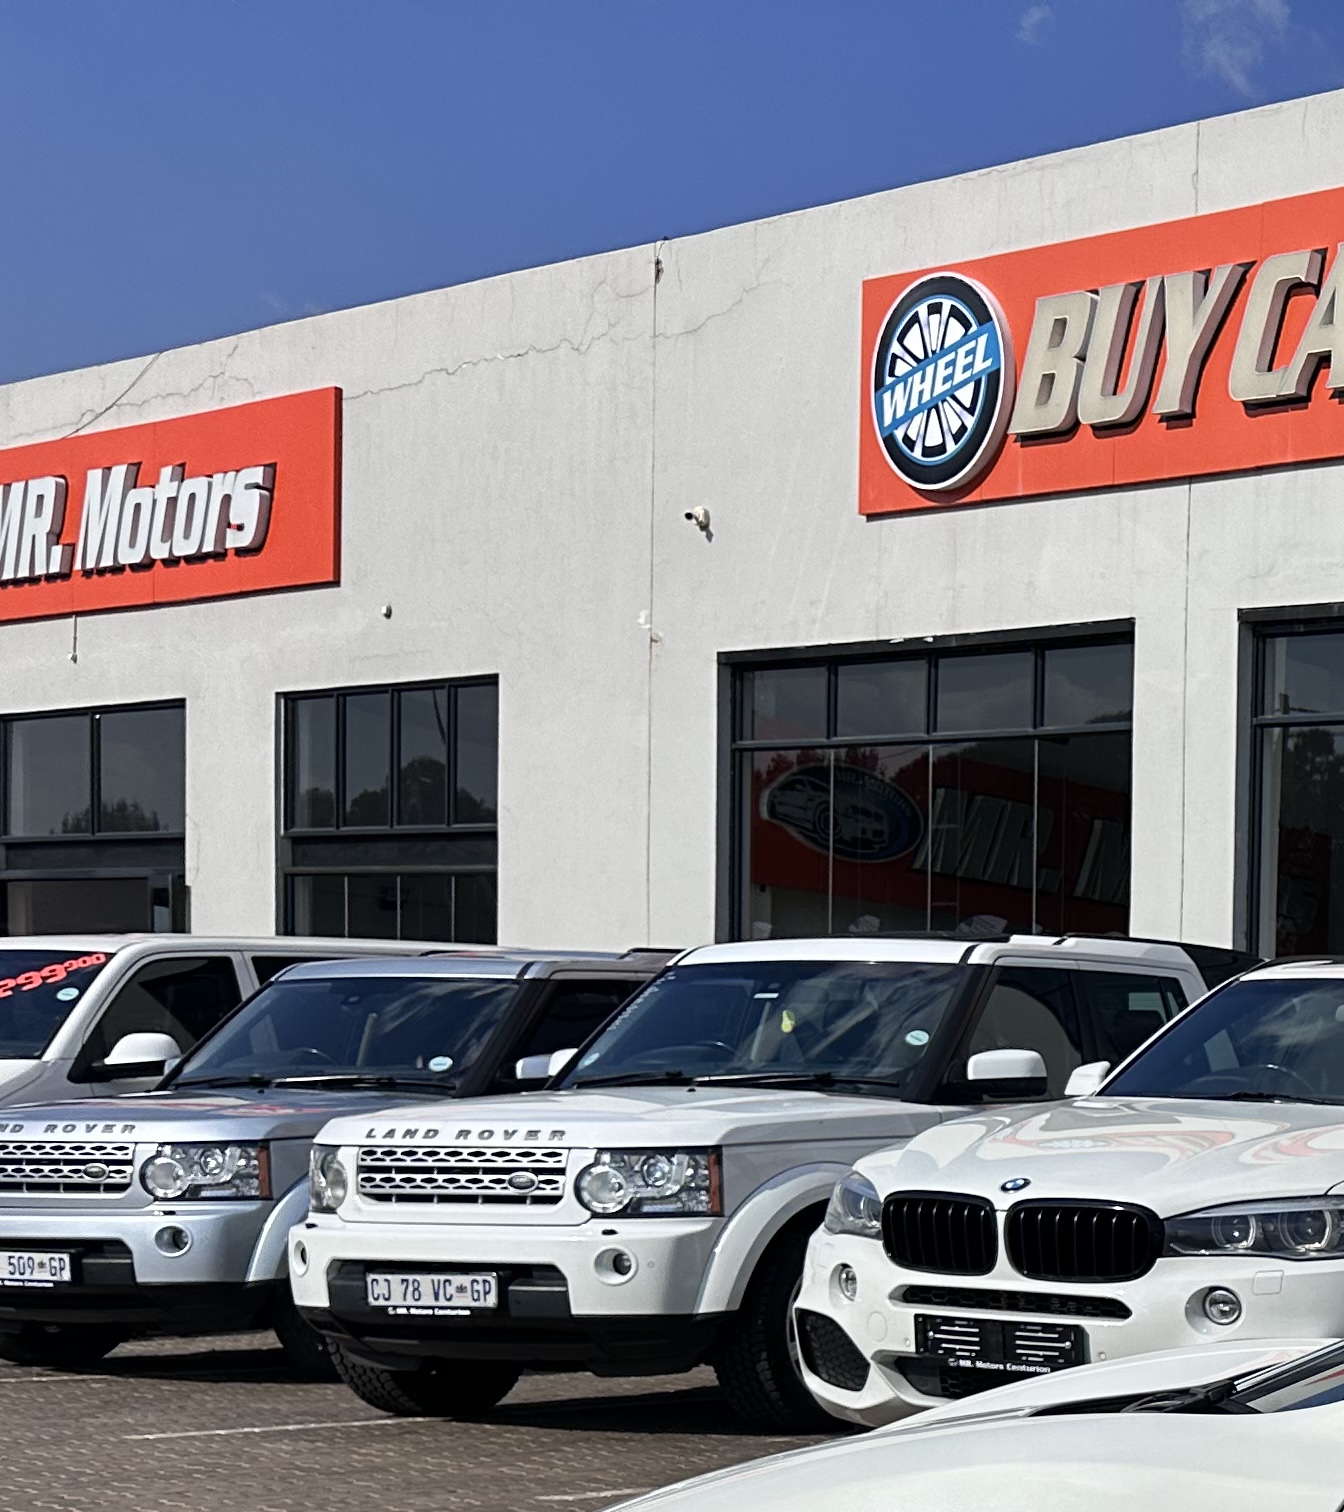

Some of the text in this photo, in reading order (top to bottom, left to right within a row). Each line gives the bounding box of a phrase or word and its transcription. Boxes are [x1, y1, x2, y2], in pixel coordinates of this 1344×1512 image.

[1008, 262, 1253, 440] BUY
[883, 332, 993, 428] WHEEL
[75, 462, 276, 572] Motors
[43, 1123, 136, 1135] ROVER
[365, 1127, 566, 1141] LAND ROVER
[8, 1255, 66, 1278] 509 GP
[371, 1278, 492, 1303] CJ 78 VC GP
